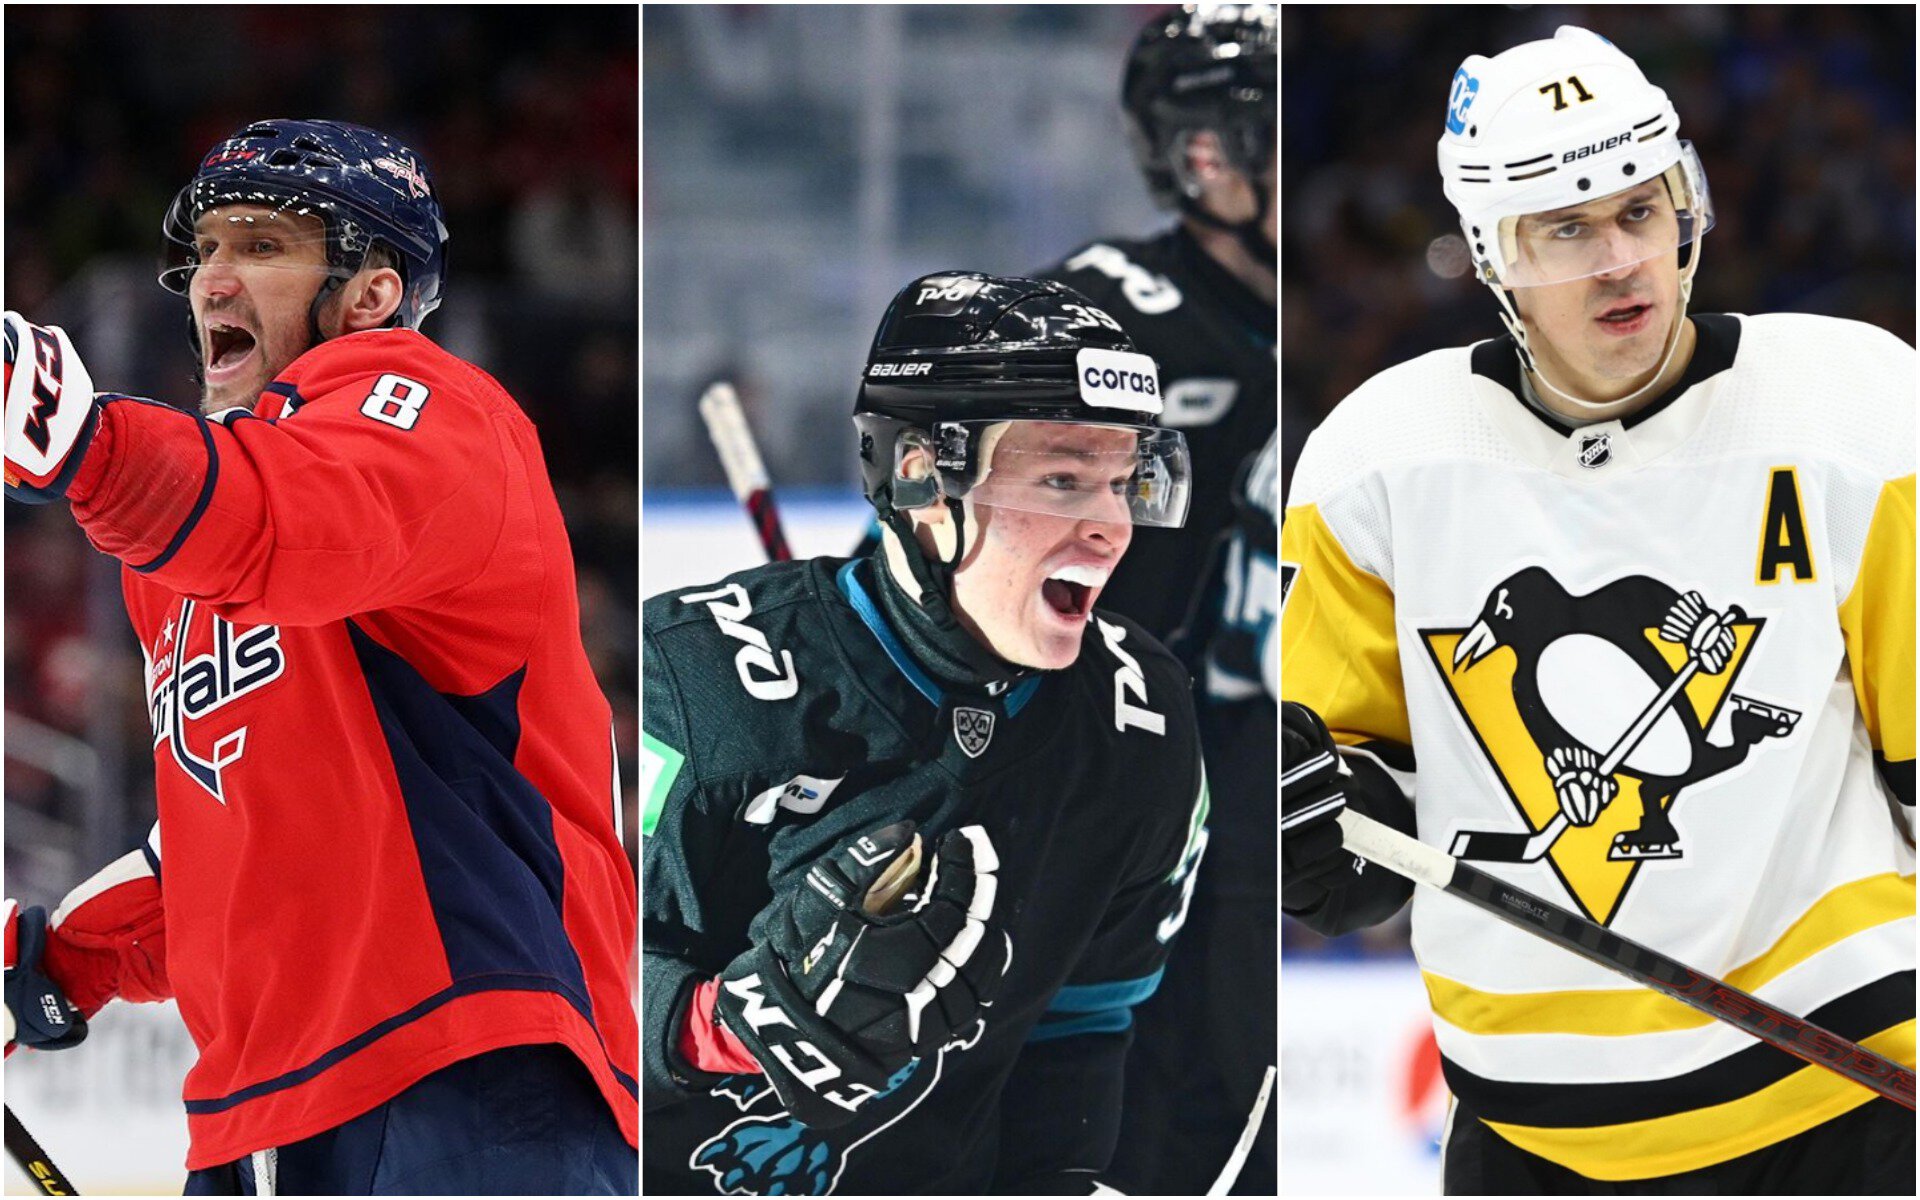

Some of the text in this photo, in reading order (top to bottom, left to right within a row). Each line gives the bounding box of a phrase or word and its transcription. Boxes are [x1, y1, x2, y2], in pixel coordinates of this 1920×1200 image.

[1539, 75, 1594, 111] 71
[1561, 131, 1632, 164] BAUER
[1061, 303, 1123, 333] 39
[869, 362, 933, 377] BAUER
[359, 372, 431, 431] 8
[1584, 440, 1607, 463] NHL
[1755, 465, 1818, 586] A
[724, 972, 881, 1113] CCM
